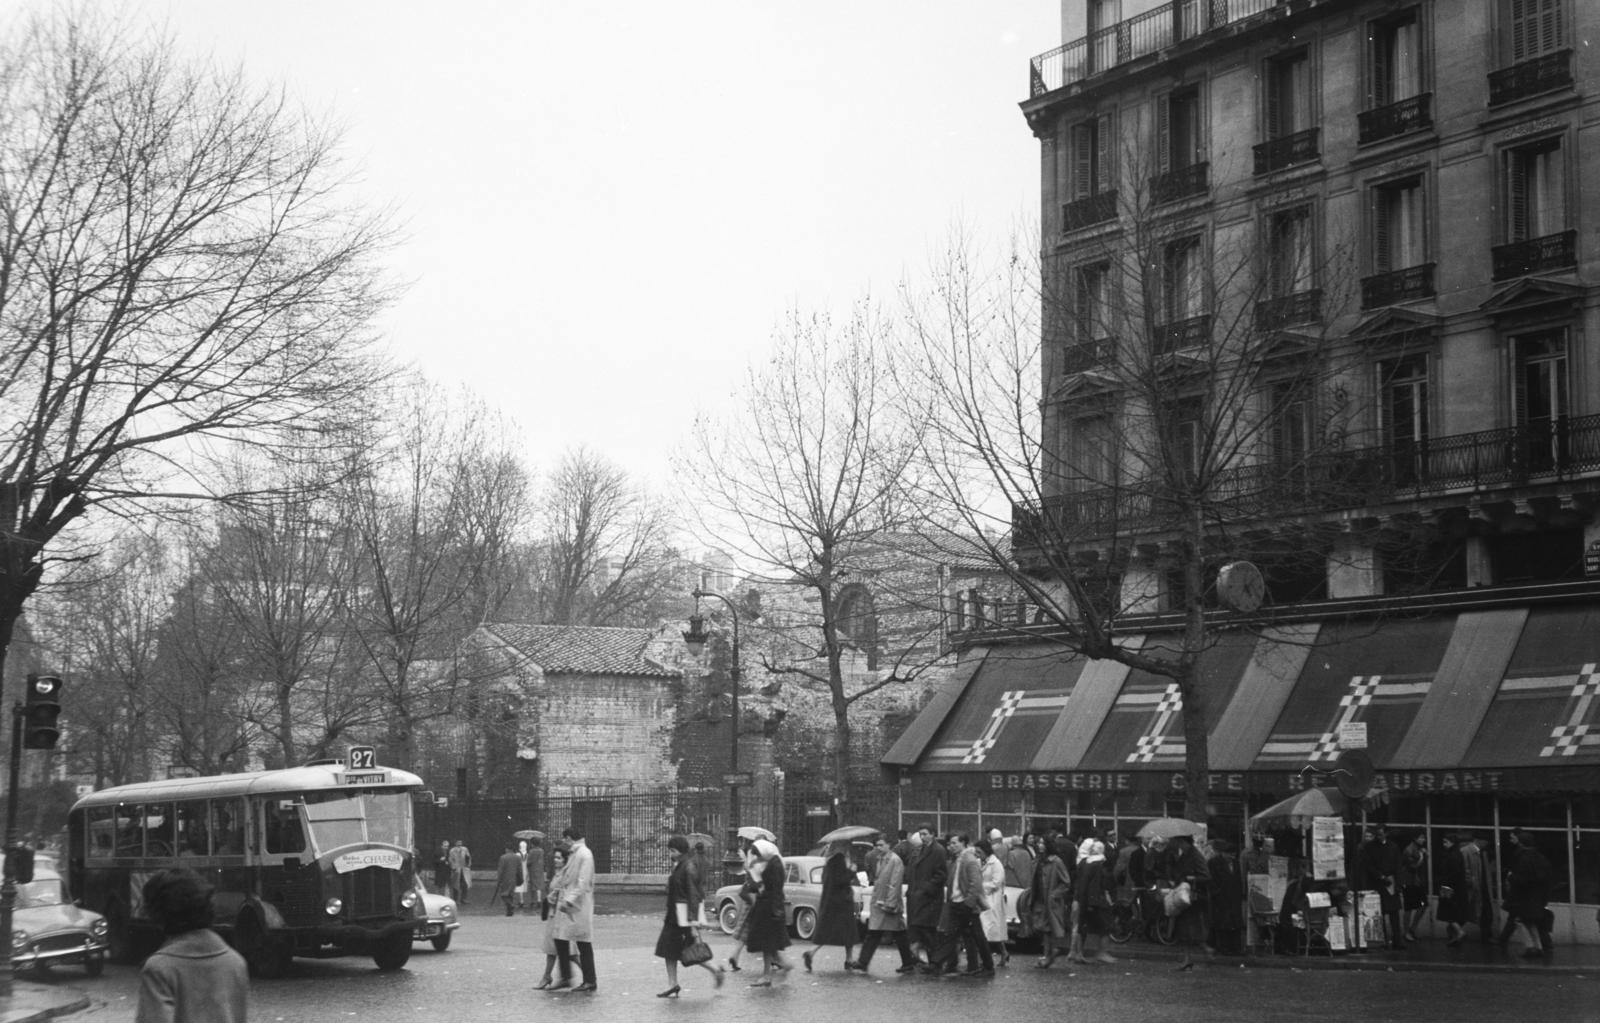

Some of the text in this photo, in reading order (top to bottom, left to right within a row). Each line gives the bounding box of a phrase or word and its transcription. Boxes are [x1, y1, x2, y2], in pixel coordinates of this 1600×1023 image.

[352, 751, 373, 768] 27
[363, 775, 382, 783] VITRY
[991, 771, 1503, 790] BRASSERIE CFE REAURANT
